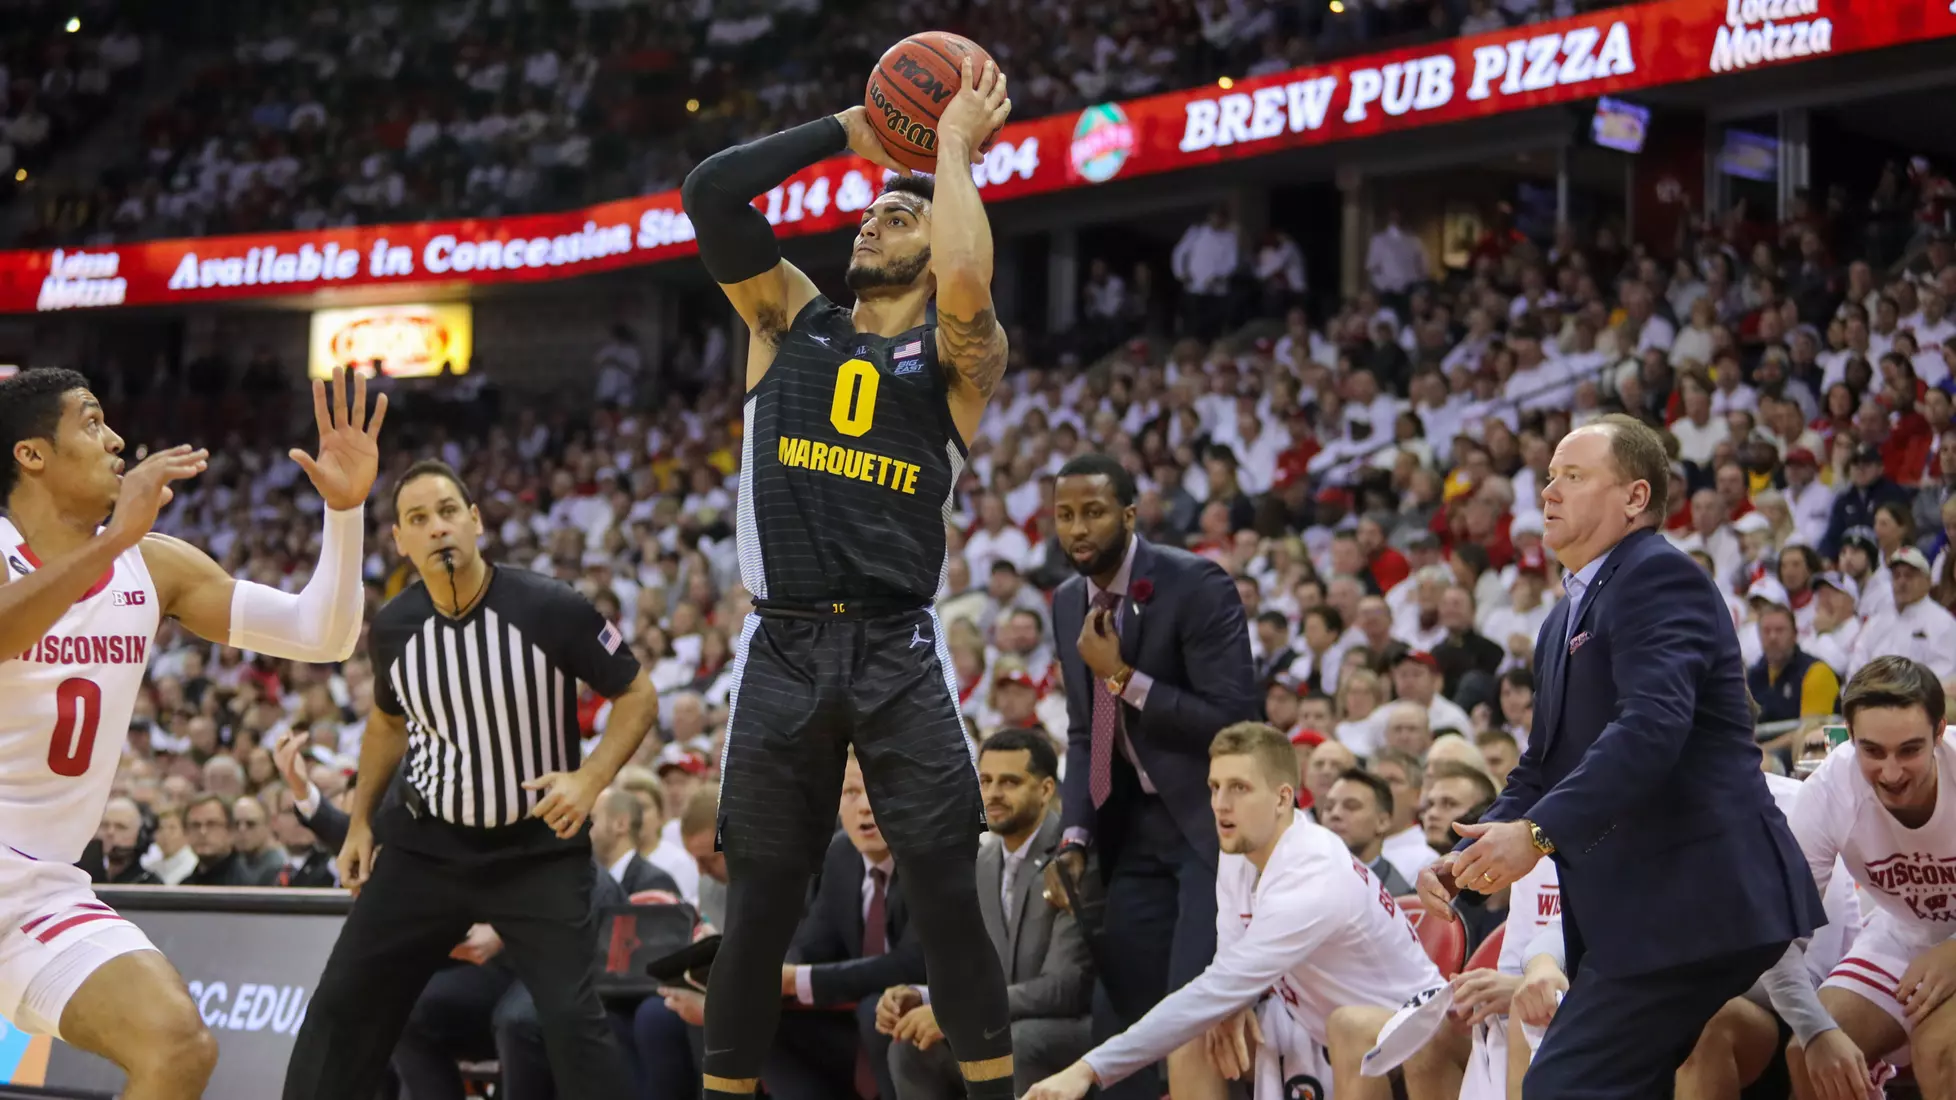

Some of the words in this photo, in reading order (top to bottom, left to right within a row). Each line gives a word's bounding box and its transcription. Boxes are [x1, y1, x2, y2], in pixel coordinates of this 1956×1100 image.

[1709, 17, 1832, 73] Motzza
[869, 80, 937, 151] Wilson
[1179, 79, 1338, 152] BREW
[1343, 55, 1455, 123] PUB
[1466, 21, 1636, 100] PIZZA
[168, 242, 360, 290] Available
[369, 238, 414, 277] in
[423, 220, 633, 274] Concession
[764, 176, 831, 226] 114
[835, 169, 874, 213] &
[829, 358, 880, 438] 0
[778, 435, 922, 495] MARQUETTE
[47, 677, 102, 777] 0
[1865, 861, 1956, 889] WISCON
